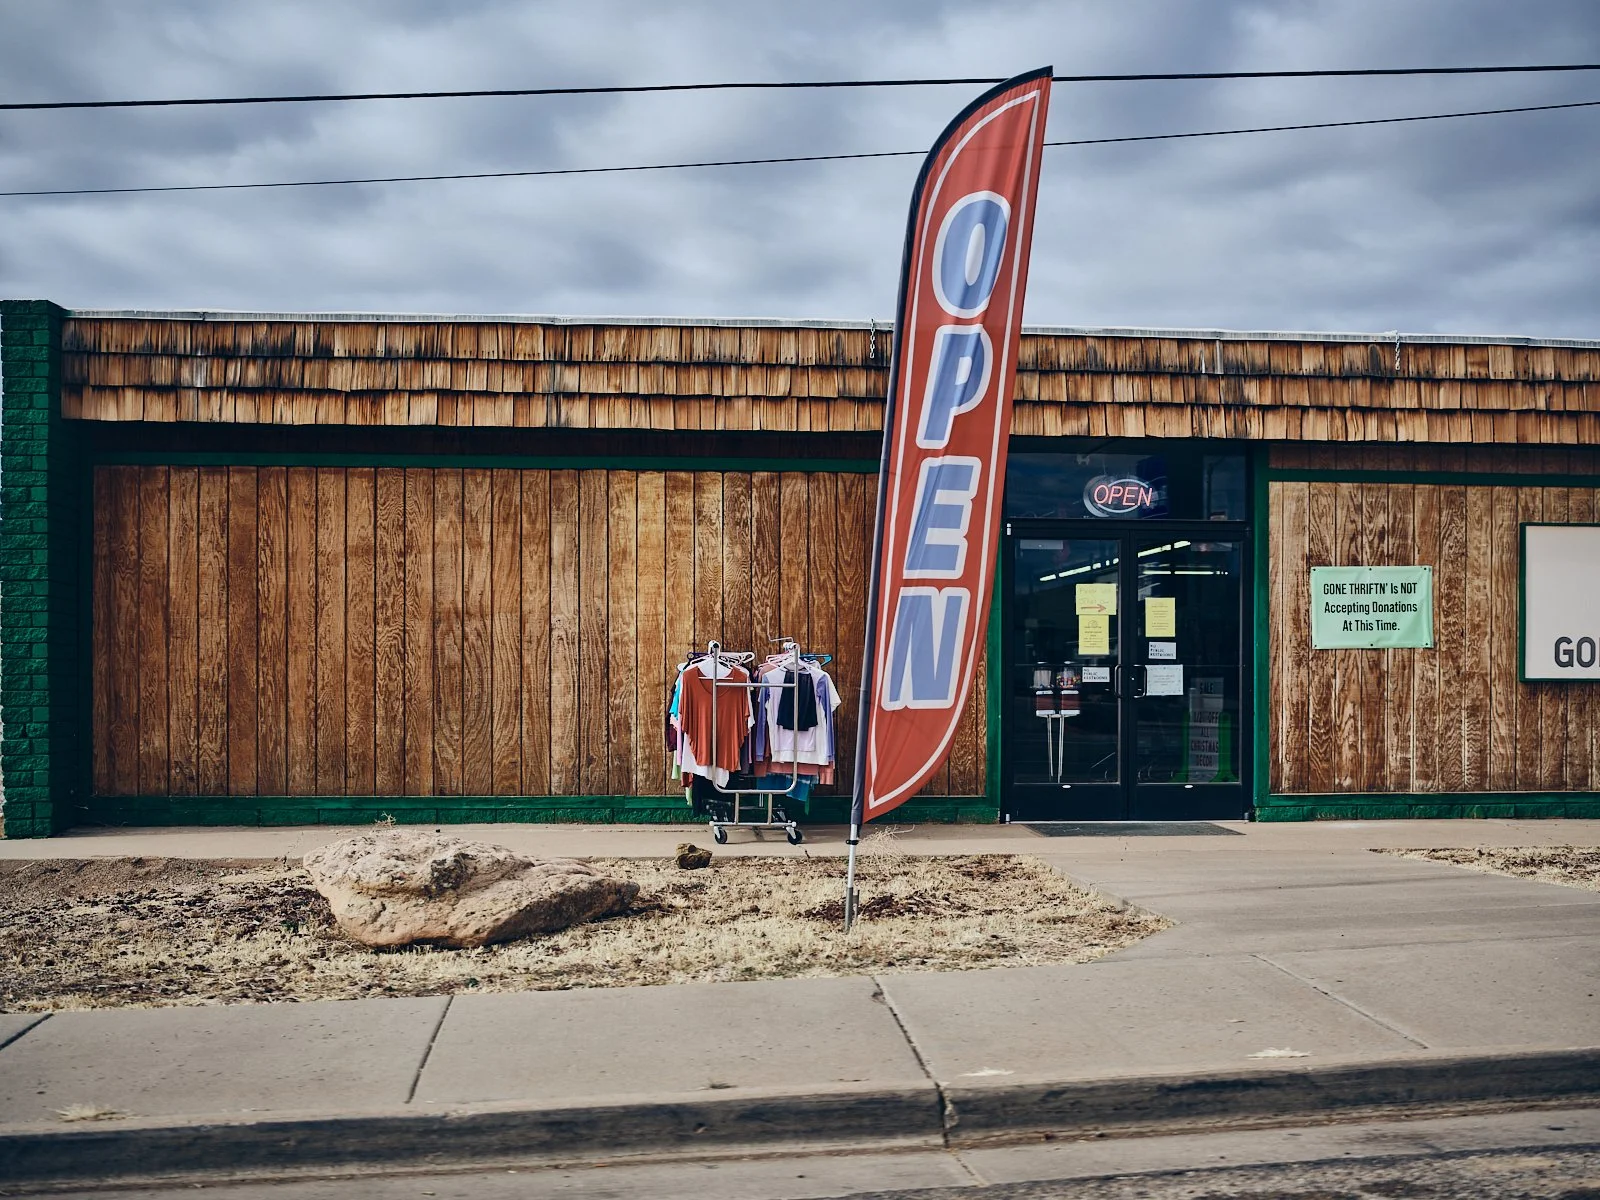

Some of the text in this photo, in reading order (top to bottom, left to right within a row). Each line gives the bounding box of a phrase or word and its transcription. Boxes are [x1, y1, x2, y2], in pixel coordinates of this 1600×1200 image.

[882, 190, 1011, 711] OPEN
[1094, 484, 1153, 507] OPEN
[1323, 582, 1418, 595] GONE THRIFTN' Is NOT
[1324, 601, 1418, 616] Accepting Donations
[1342, 619, 1400, 632] At This Time.
[1554, 636, 1600, 668] GO
[1200, 682, 1214, 695] SALE
[1191, 739, 1219, 753] CHRISTMAS
